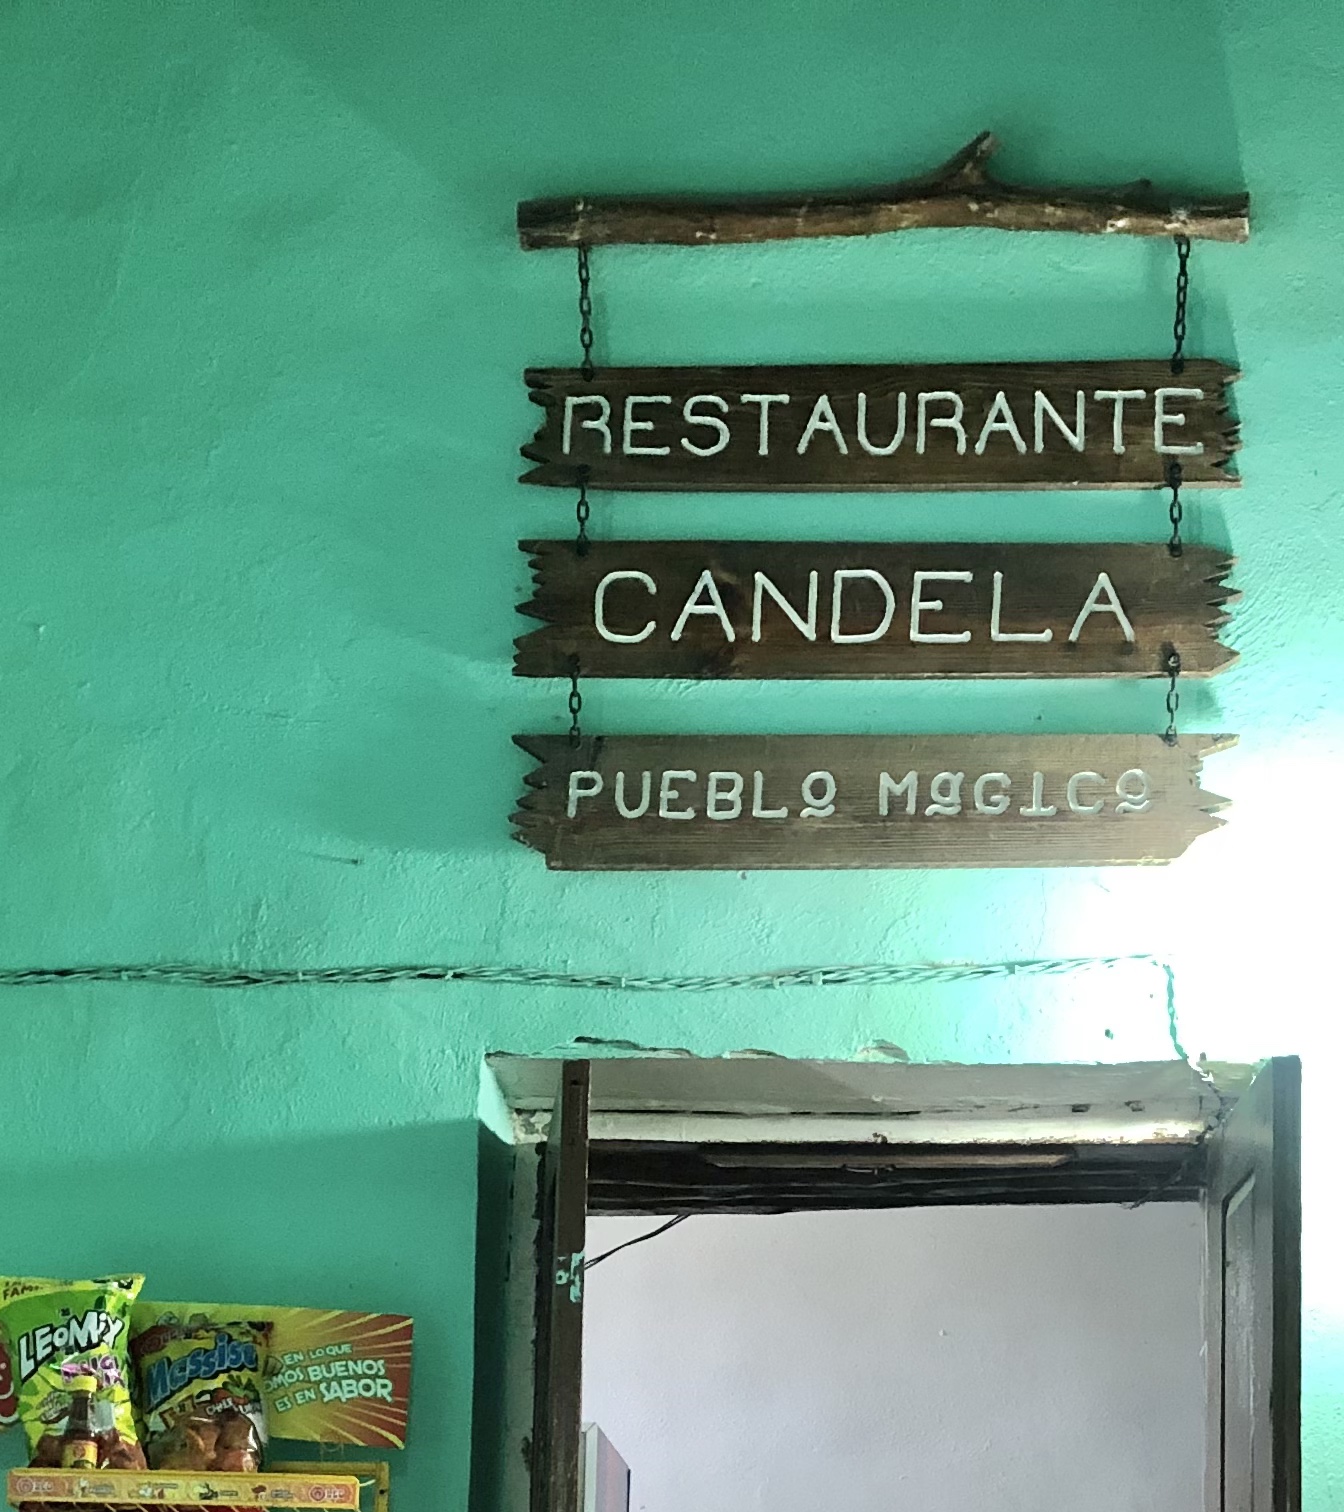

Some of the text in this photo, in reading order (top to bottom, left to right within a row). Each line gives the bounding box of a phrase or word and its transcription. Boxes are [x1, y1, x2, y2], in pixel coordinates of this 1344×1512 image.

[561, 388, 1205, 457] RESTAURANTE
[594, 570, 1135, 645] CANDELA
[567, 769, 837, 821] PUEBLO
[283, 1352, 304, 1367] EN
[306, 1359, 387, 1382] BUENOS
[275, 1378, 394, 1413] ES EN SABOR
